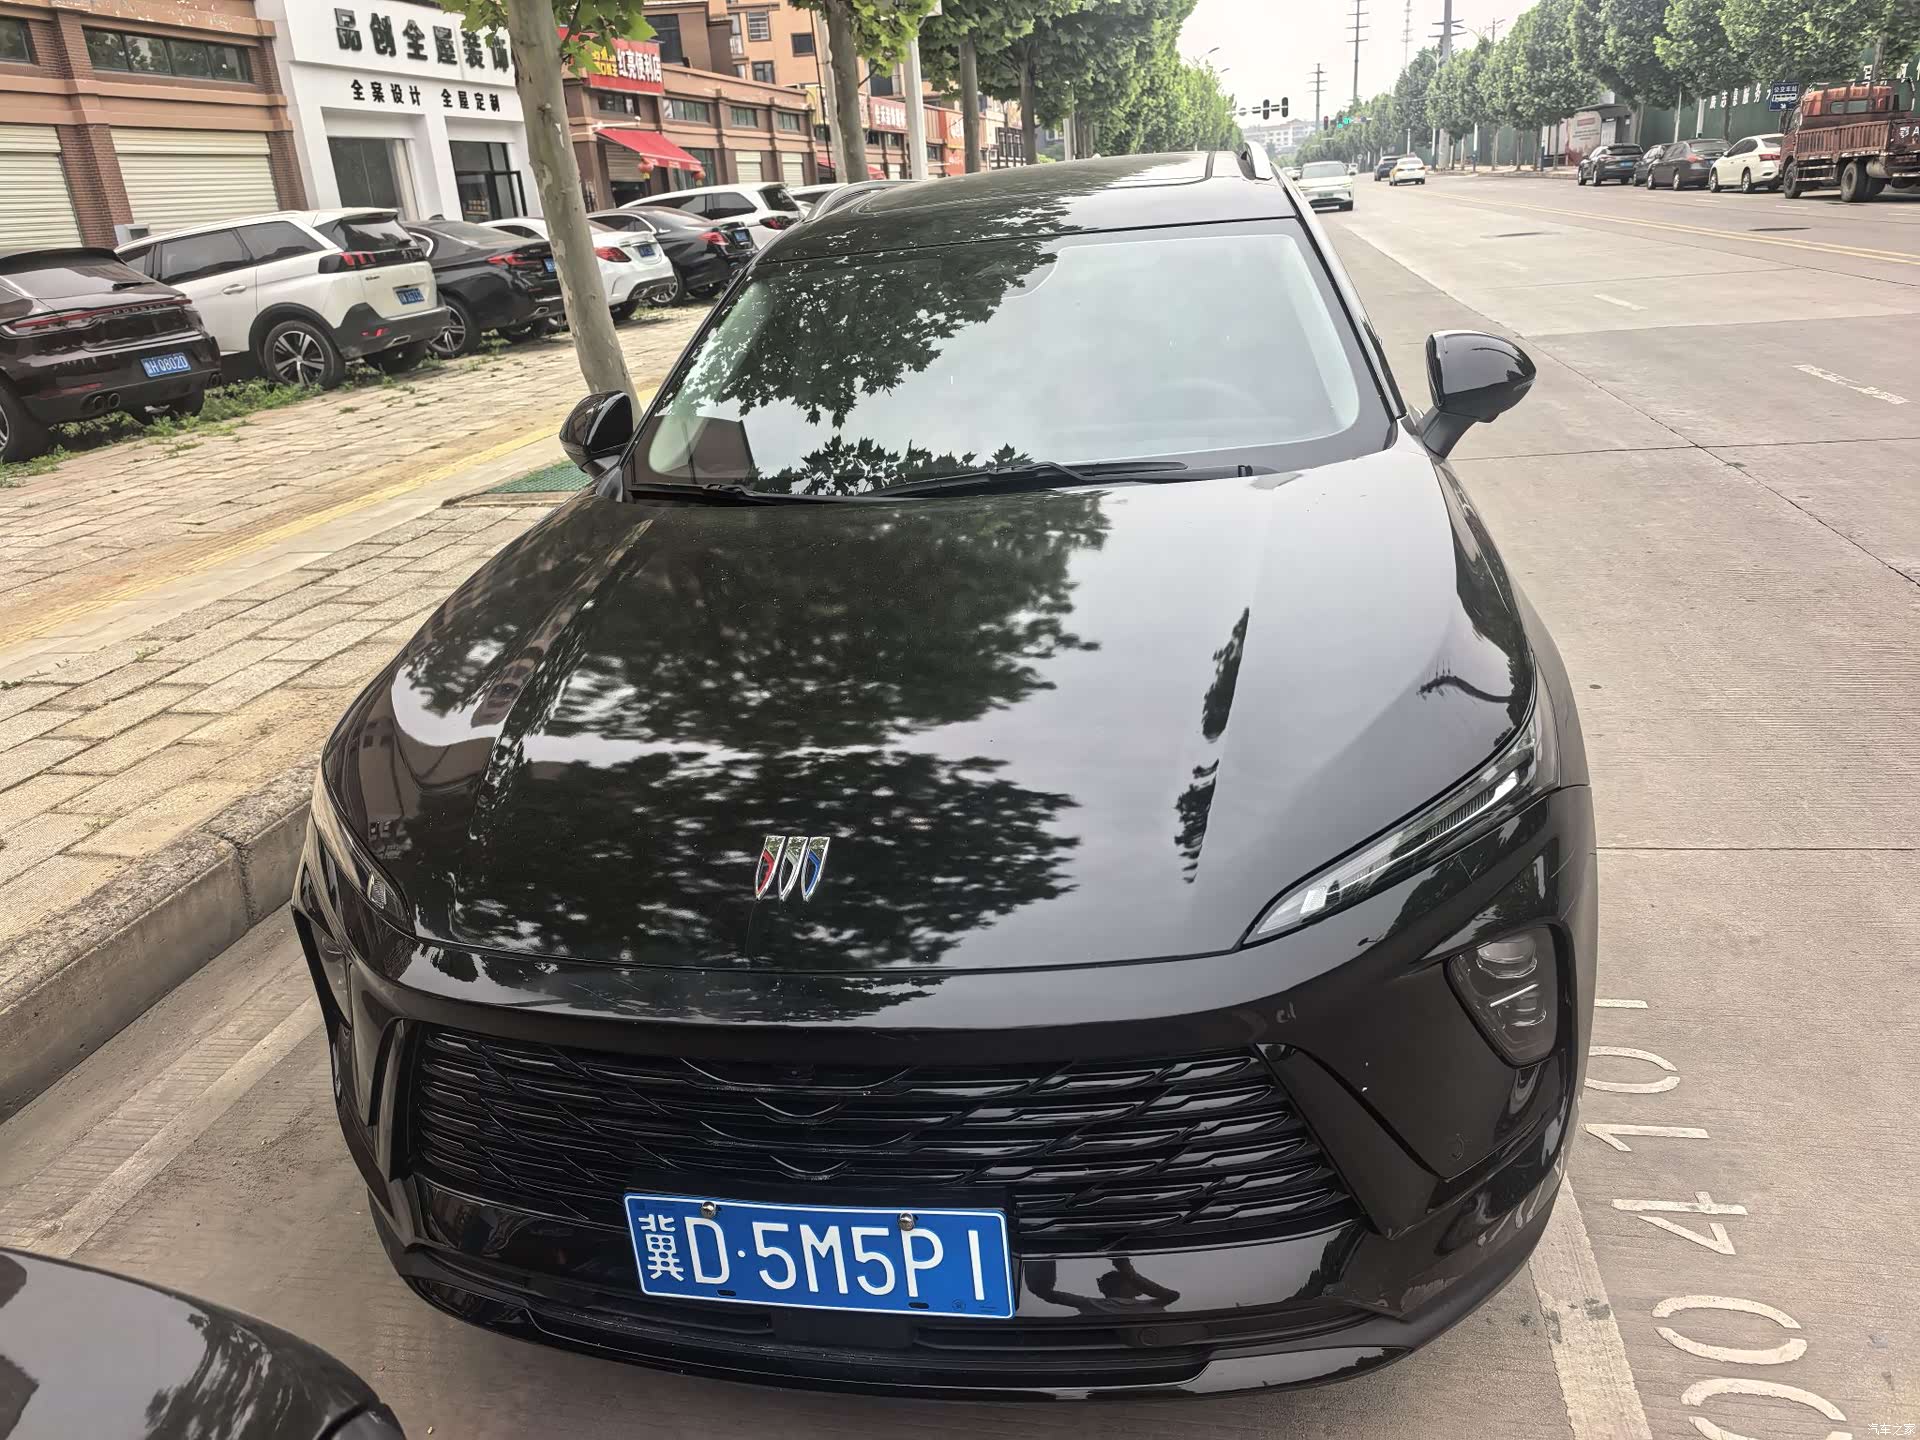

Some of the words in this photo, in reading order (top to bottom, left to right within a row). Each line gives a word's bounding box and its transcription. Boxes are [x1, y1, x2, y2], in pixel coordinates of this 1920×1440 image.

[351, 79, 421, 106] 全案设计
[441, 88, 501, 112] 全屋定制
[638, 1213, 985, 1301] 冀D·5M5P1
